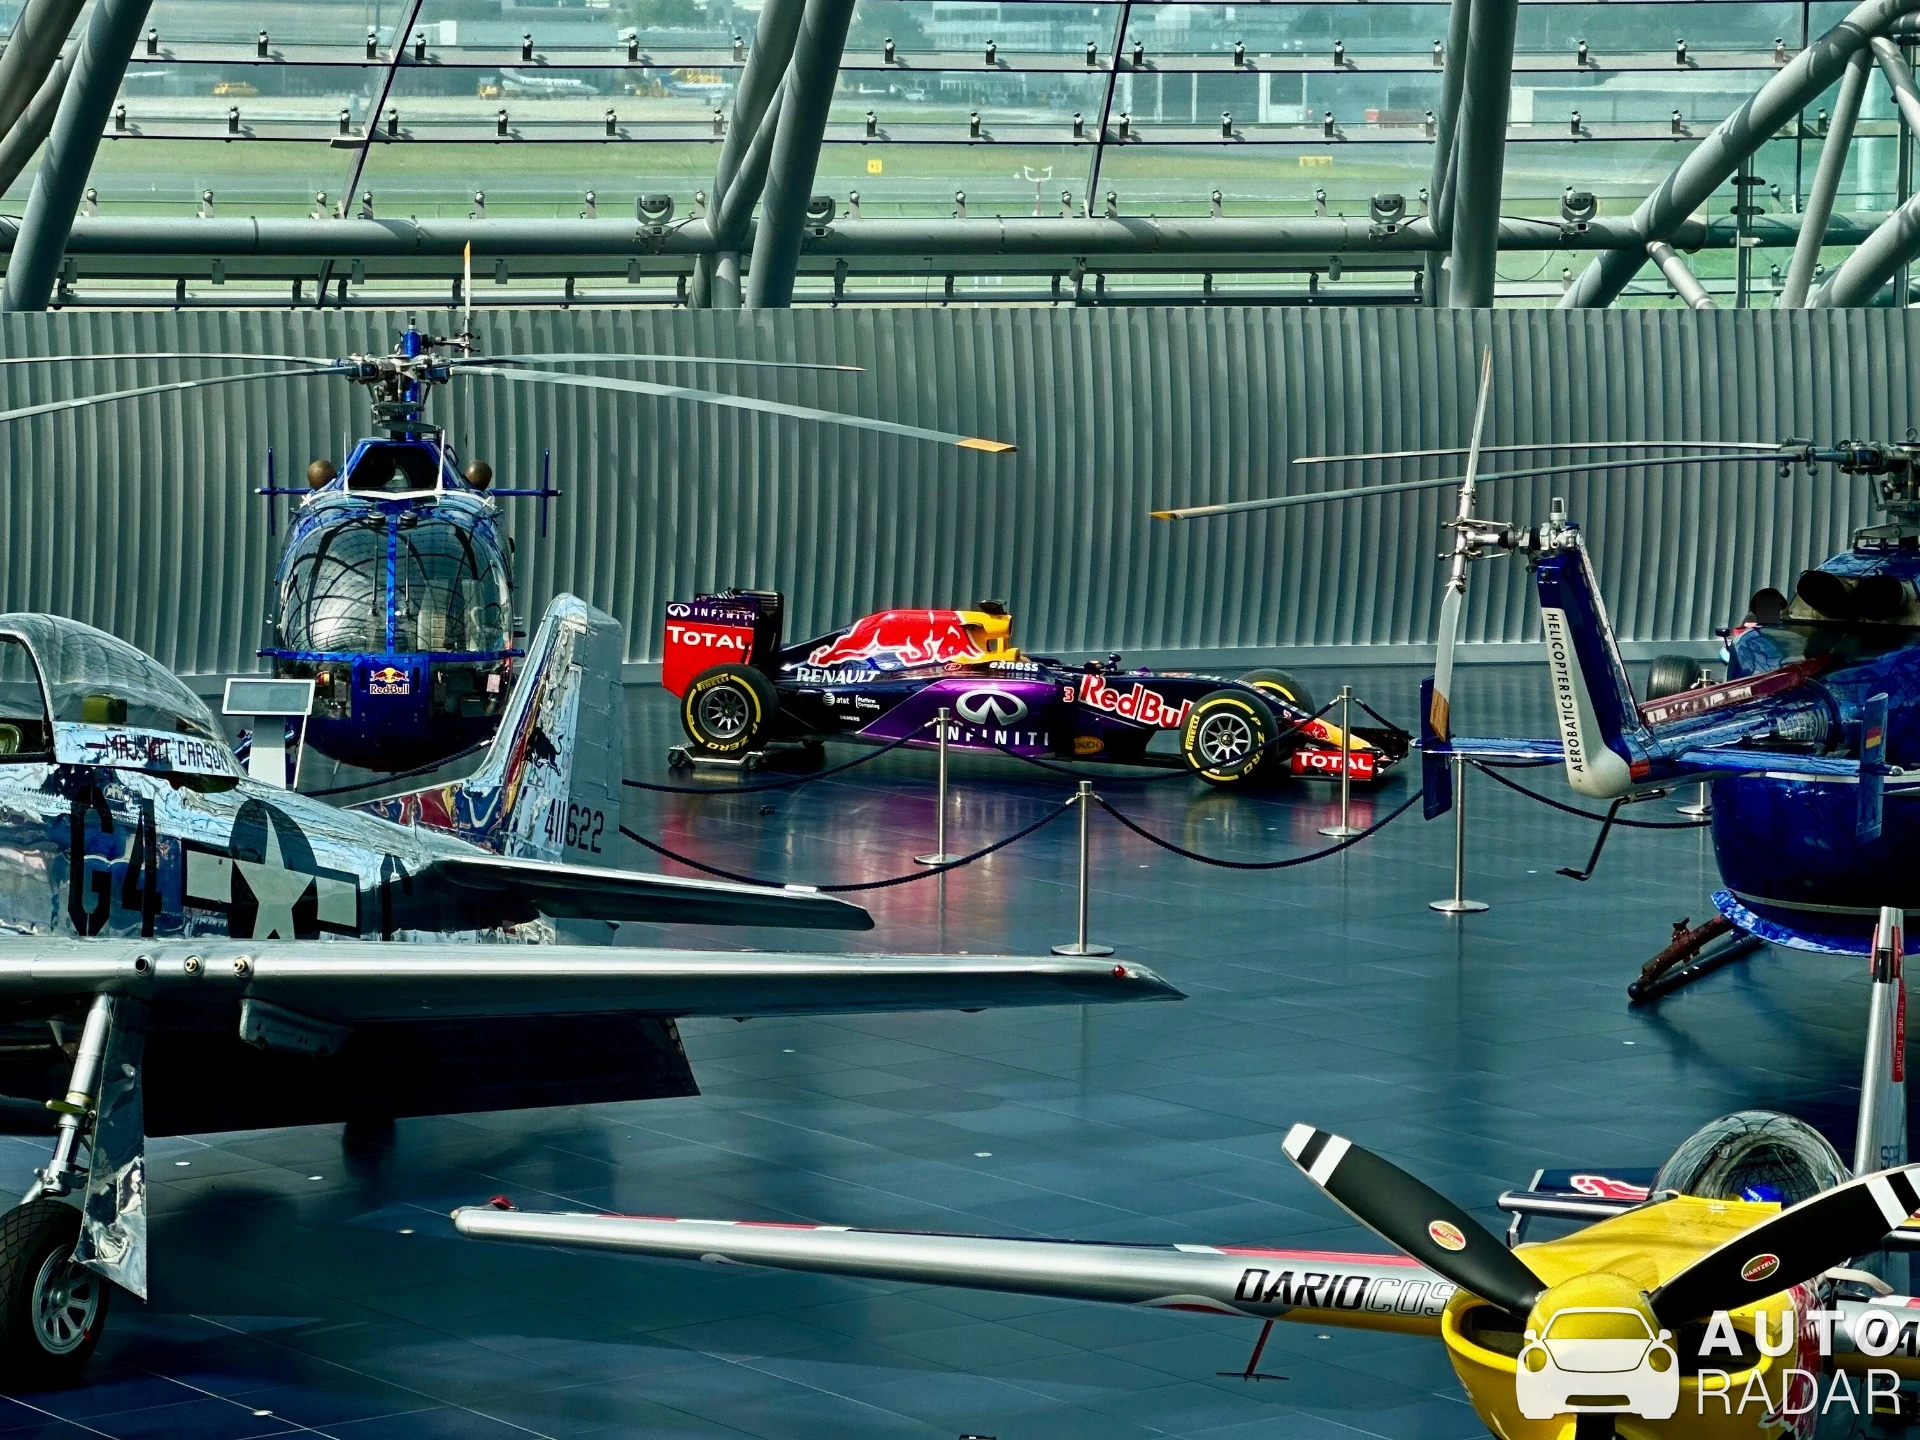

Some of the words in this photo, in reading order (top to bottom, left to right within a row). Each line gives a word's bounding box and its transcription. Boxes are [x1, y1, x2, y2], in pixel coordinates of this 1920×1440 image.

[666, 625, 746, 650] TOTAL
[1547, 613, 1570, 691] HELICOPTER
[795, 667, 880, 685] RENAULT
[989, 661, 1039, 672] exness
[1063, 686, 1075, 703] 3
[1561, 694, 1584, 772] AEROBATICS
[1743, 1259, 1777, 1278] HARTZELL
